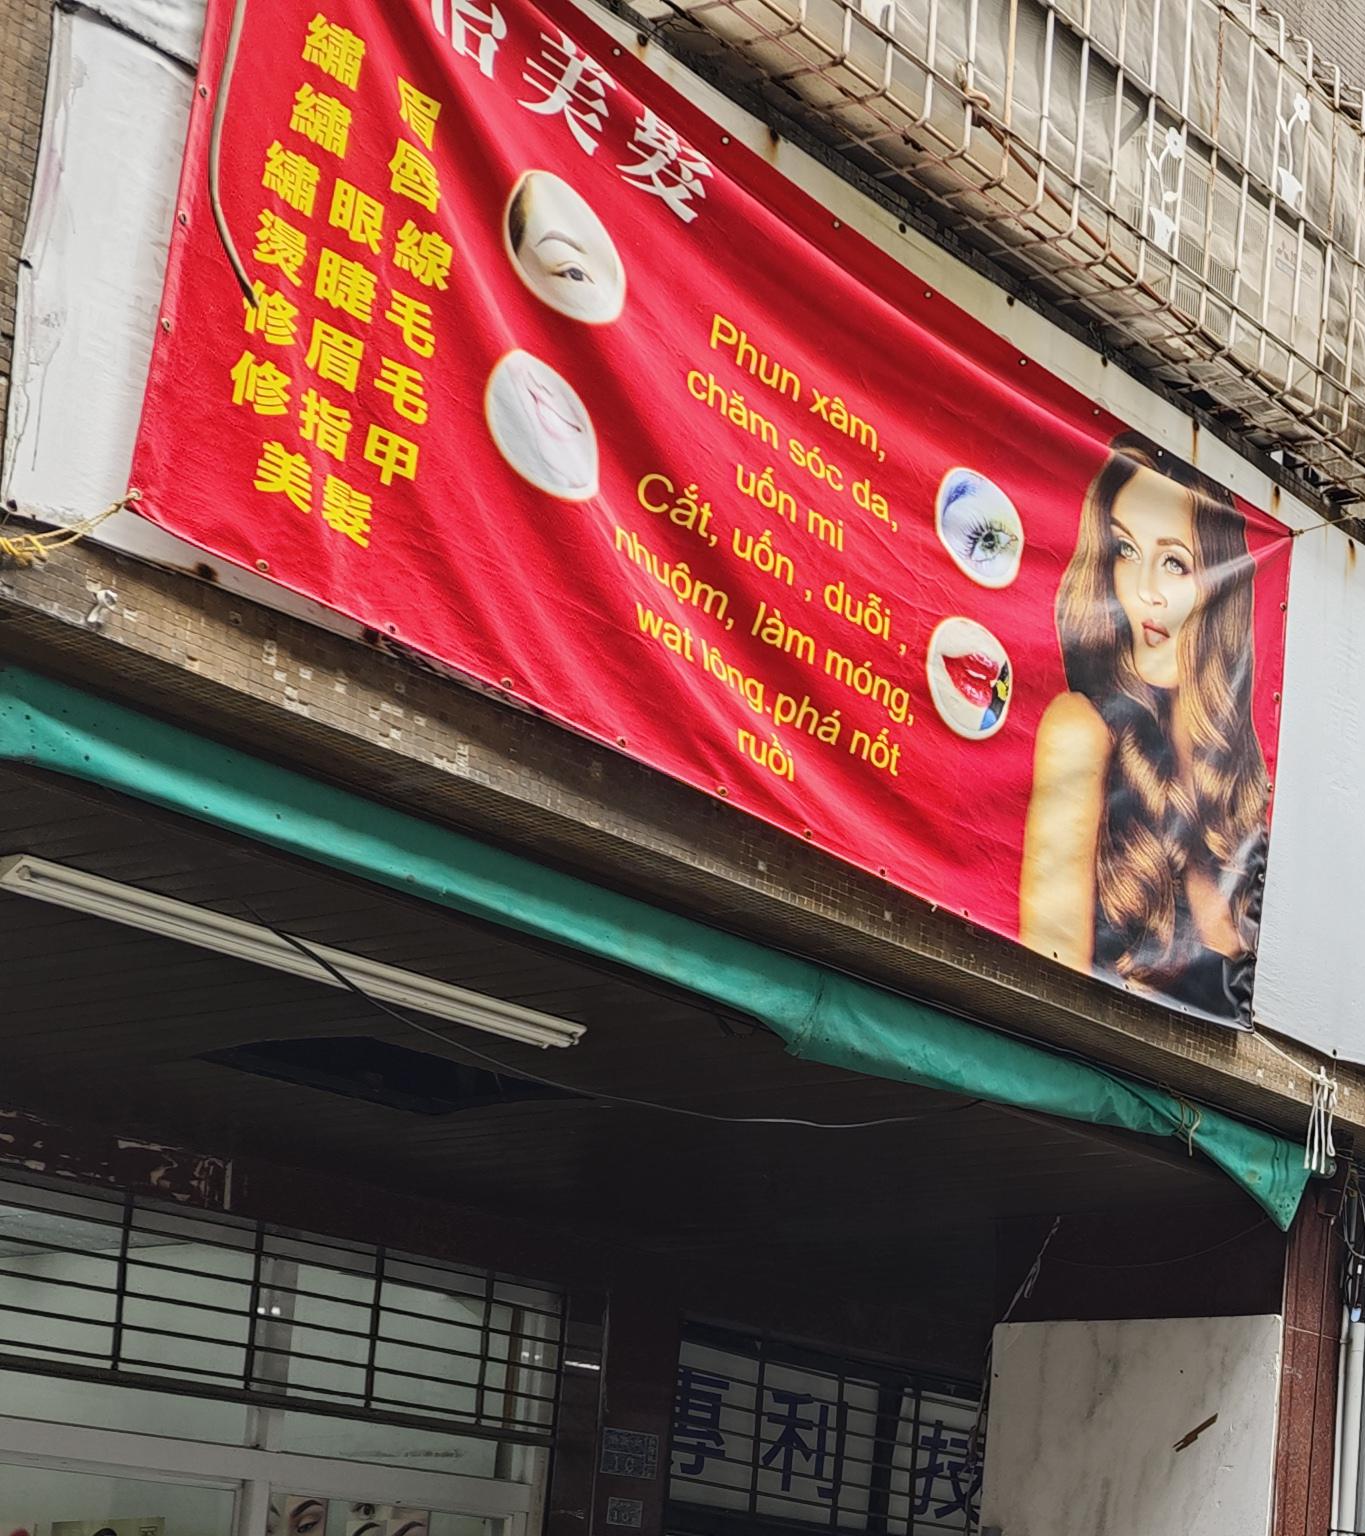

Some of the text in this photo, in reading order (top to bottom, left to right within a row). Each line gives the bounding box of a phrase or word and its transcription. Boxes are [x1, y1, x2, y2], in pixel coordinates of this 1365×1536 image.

[230, 349, 420, 487] 修指甲
[242, 279, 430, 426] 修眉毛
[710, 314, 887, 464] Phun xâm,
[253, 440, 374, 548] 美髮
[686, 366, 901, 533] chăm sóc da,
[806, 510, 846, 553] mi
[750, 604, 816, 666] làm
[824, 637, 917, 727] móng,
